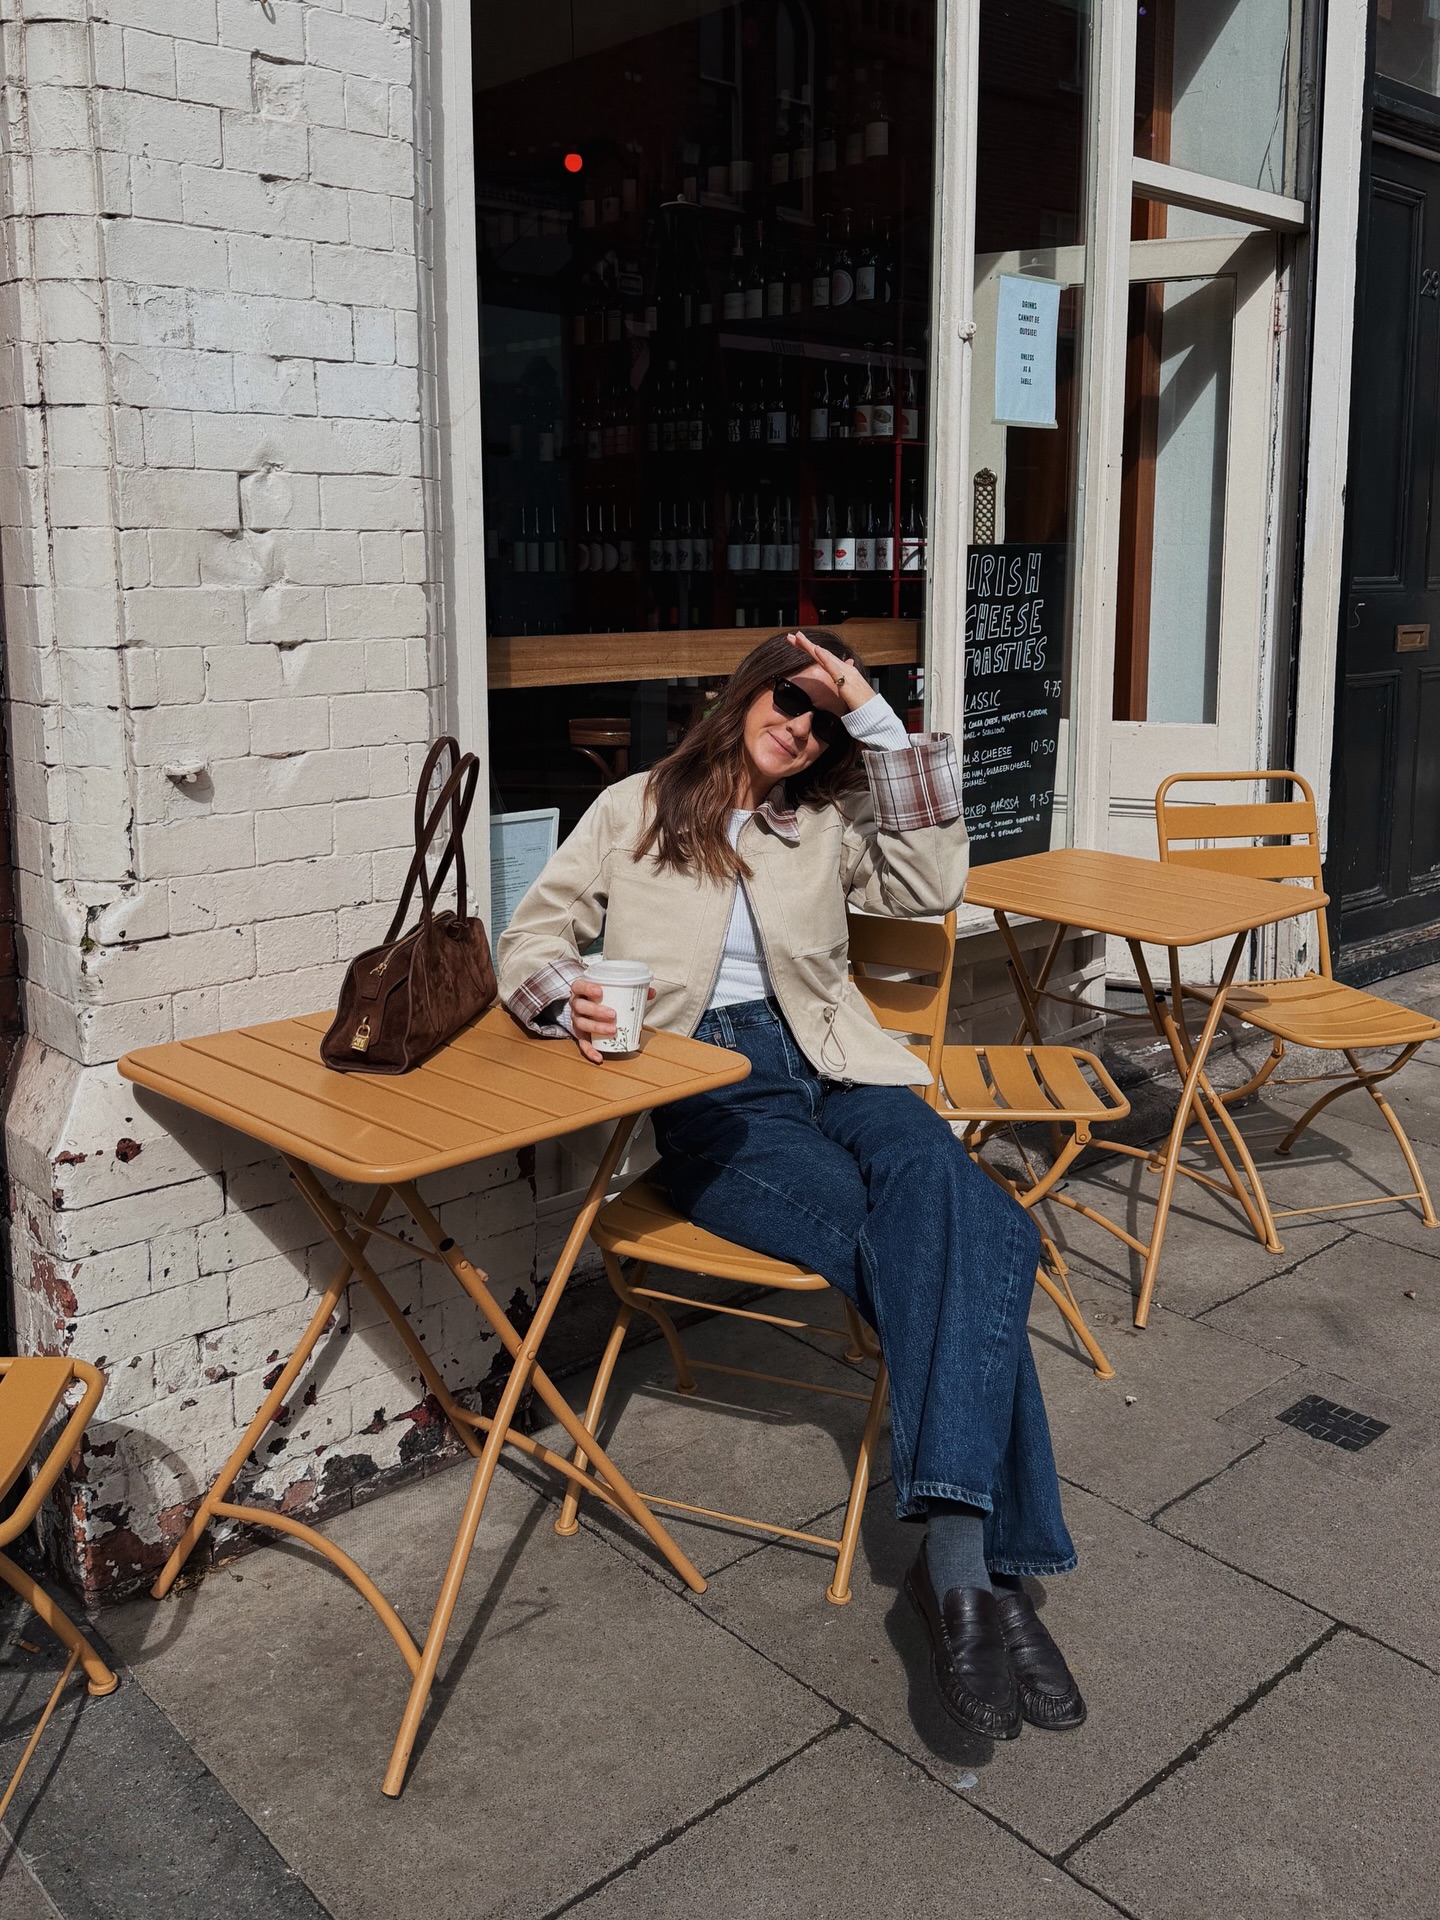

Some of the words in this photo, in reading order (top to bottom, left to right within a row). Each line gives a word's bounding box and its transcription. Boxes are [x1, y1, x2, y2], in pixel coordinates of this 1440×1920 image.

[1022, 300, 1037, 309] DRINKS
[1018, 313, 1034, 323] CANNOT
[1034, 315, 1040, 324] BE
[1020, 353, 1035, 361] UNLESS
[967, 552, 1042, 597] IRISH
[964, 599, 1044, 643] CHEESE
[963, 635, 1047, 679] TOASTIES
[964, 689, 1001, 712] LASSIC
[980, 745, 1012, 761] CHEESE
[964, 803, 987, 817] OKED
